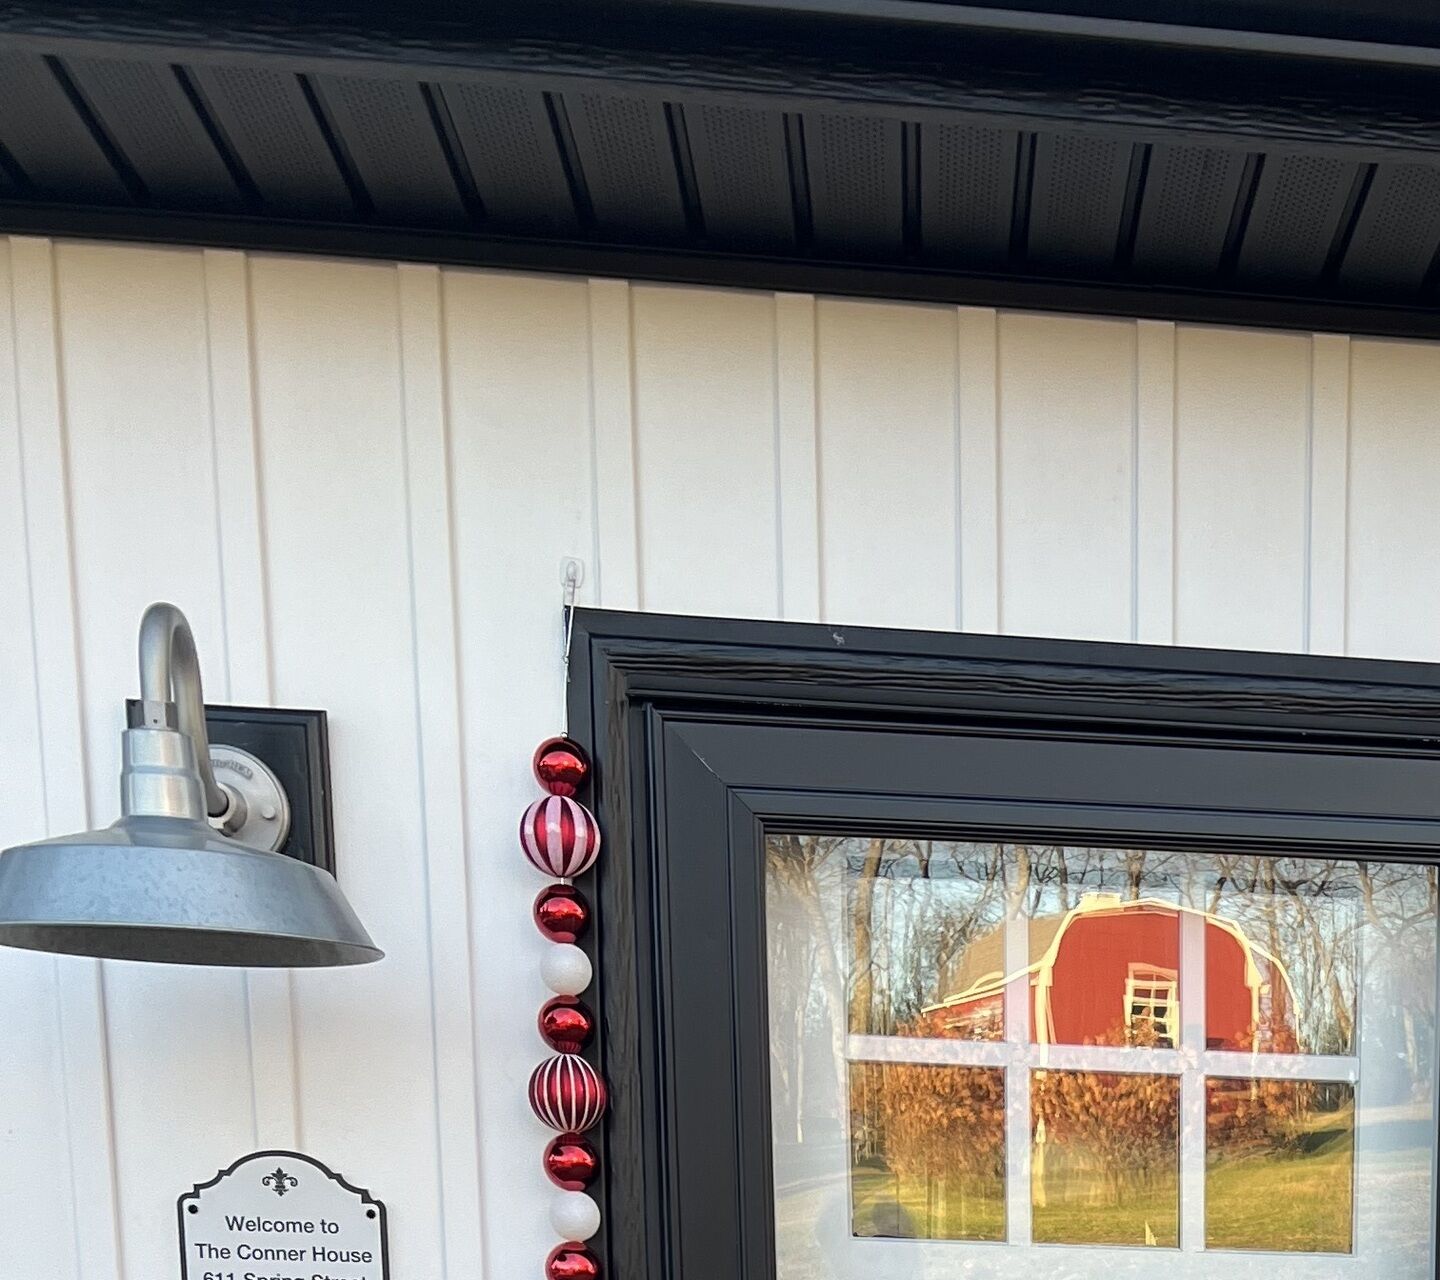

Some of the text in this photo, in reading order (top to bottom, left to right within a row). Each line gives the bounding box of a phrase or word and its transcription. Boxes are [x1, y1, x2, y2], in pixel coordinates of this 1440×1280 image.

[225, 1216, 340, 1234] Welcome to
[194, 1243, 373, 1263] The Conner House
